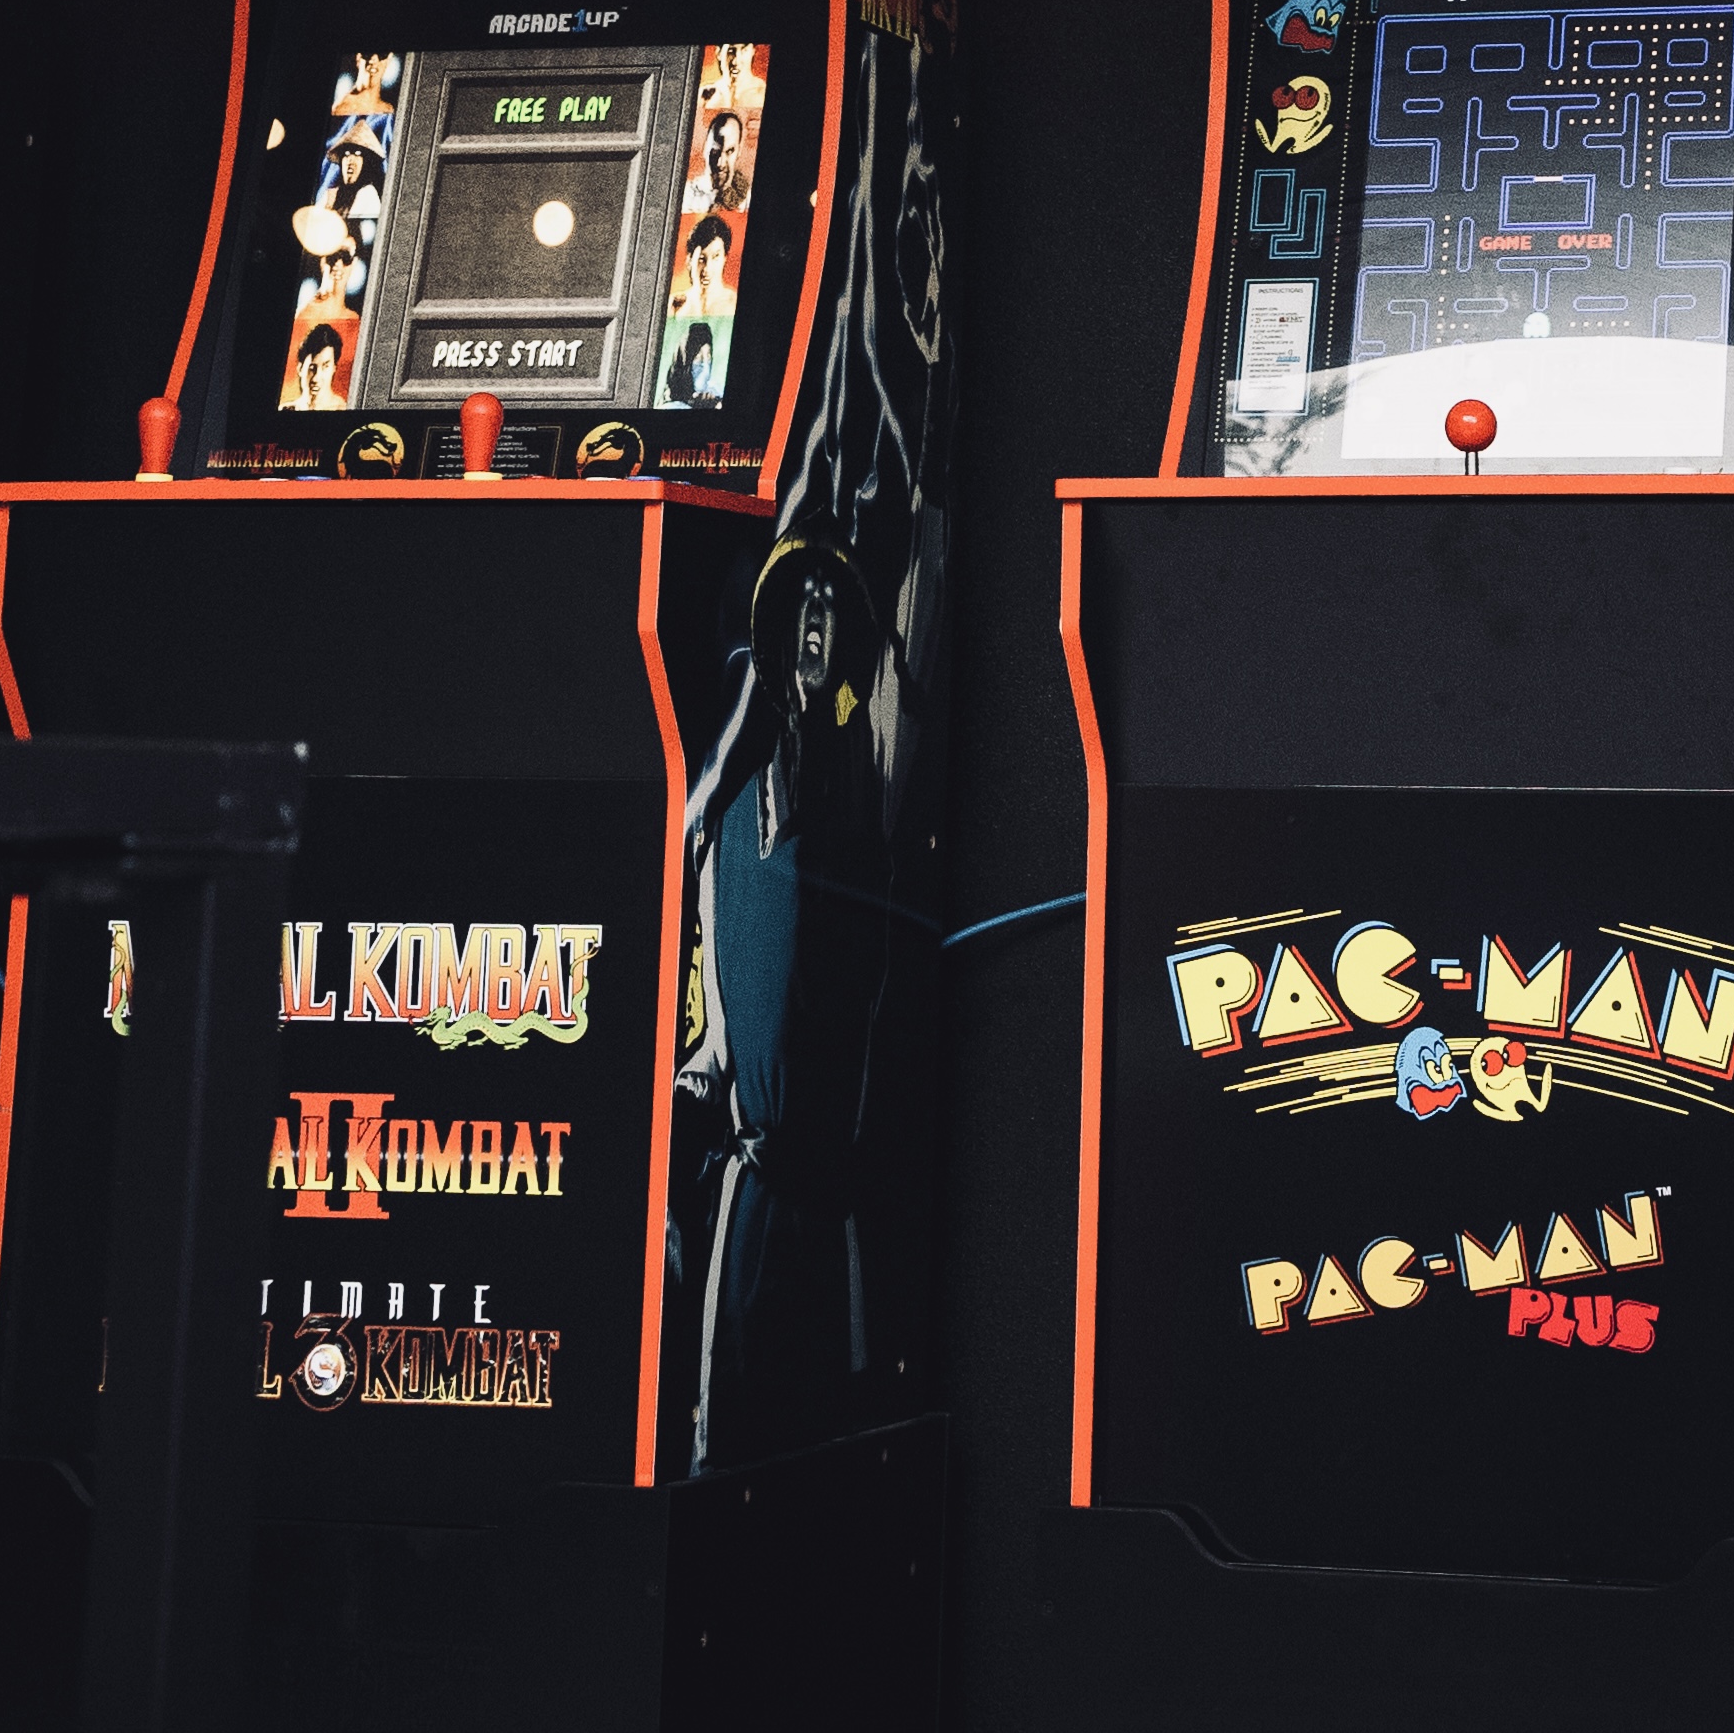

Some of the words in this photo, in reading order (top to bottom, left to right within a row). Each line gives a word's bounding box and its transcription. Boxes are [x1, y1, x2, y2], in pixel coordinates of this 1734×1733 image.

[493, 96, 548, 124] FREE
[558, 95, 613, 122] PLAY
[1478, 234, 1533, 252] GAME
[1556, 232, 1614, 251] OVER
[431, 339, 504, 368] PRESS
[507, 338, 585, 369] START
[343, 922, 603, 1024] KOMBAT
[341, 1118, 572, 1197] KOMBAT
[1240, 1190, 1665, 1336] PAC-MAN
[260, 1278, 492, 1324] TIMATE
[1507, 1285, 1660, 1355] PLUS
[360, 1324, 562, 1408] KOMBAT
